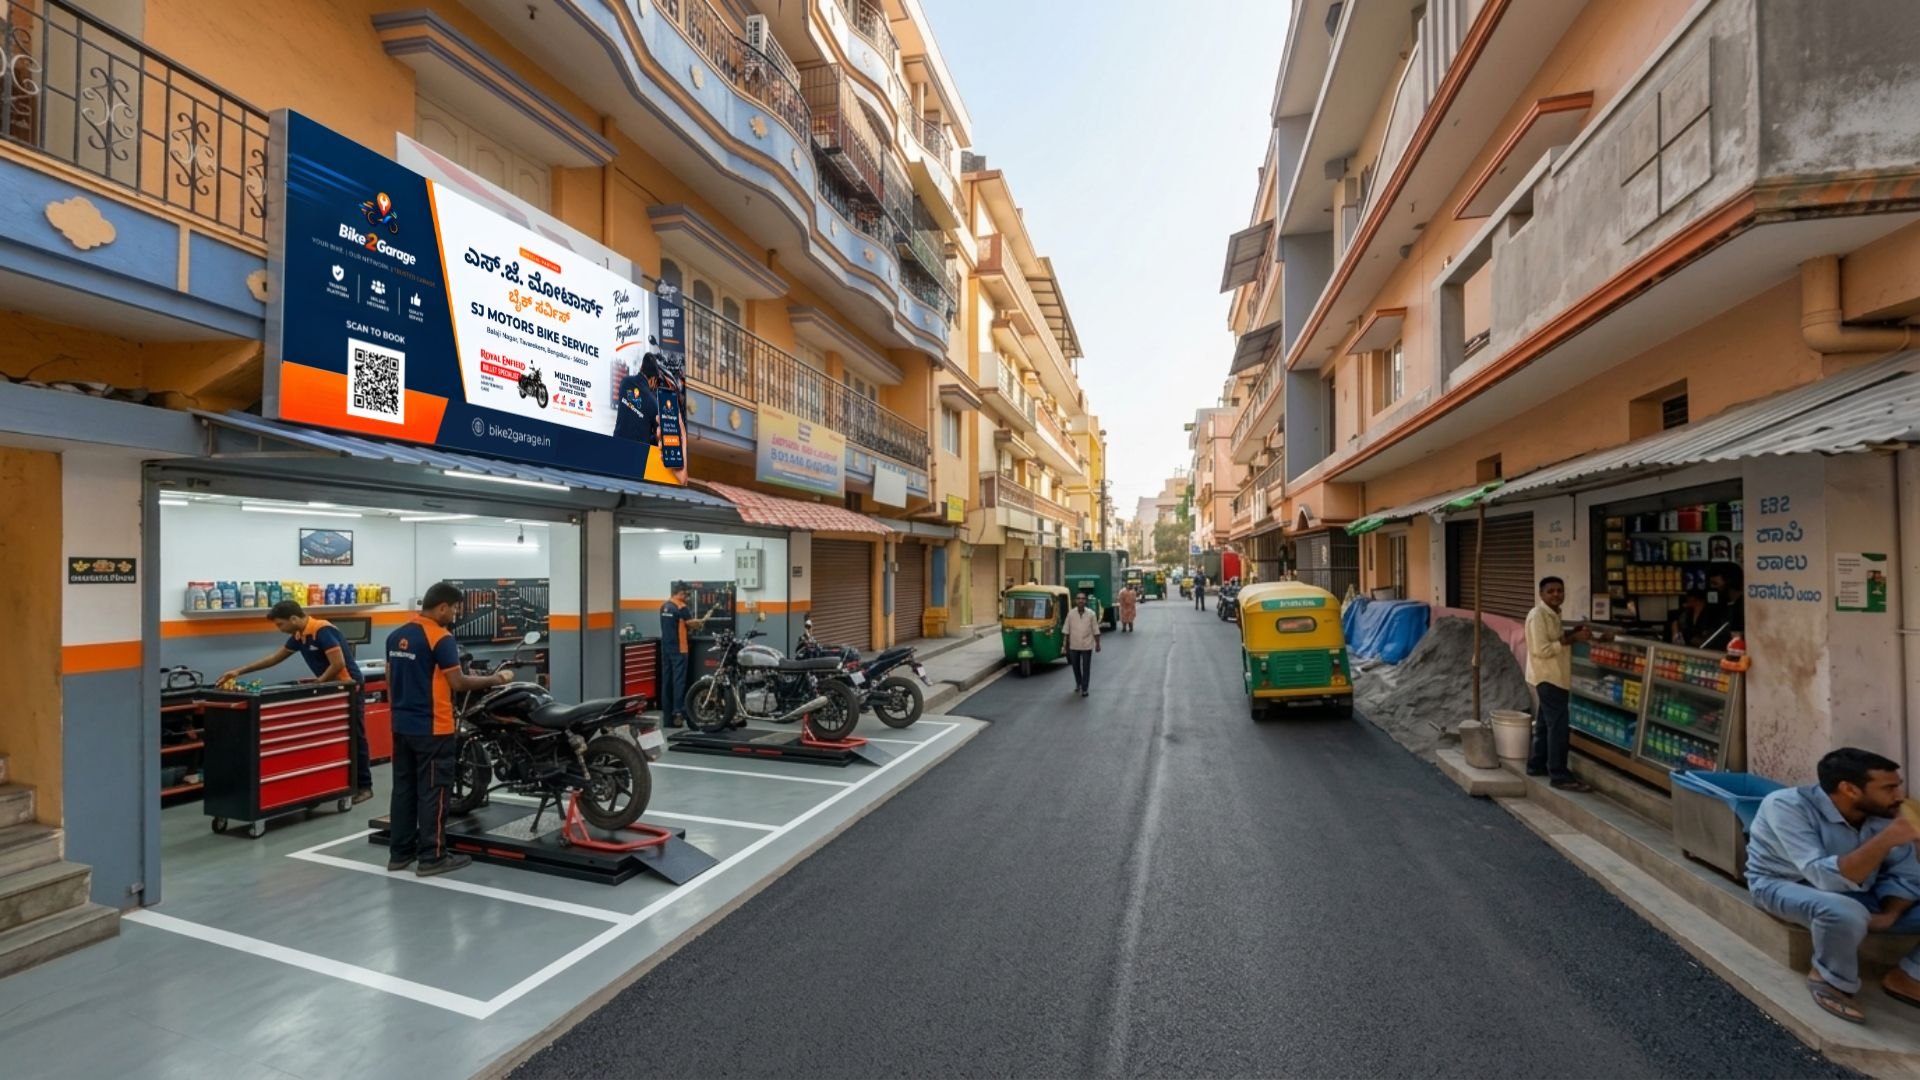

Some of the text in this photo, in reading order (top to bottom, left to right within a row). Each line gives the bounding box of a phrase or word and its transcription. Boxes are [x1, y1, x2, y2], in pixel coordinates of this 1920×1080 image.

[338, 223, 417, 266] Bike2Garage
[346, 320, 406, 344] SCAN TO BOOK
[471, 301, 600, 358] SJ MOTORS BIKE SERVICE
[486, 326, 501, 338] Balaji
[614, 322, 640, 344] Together
[480, 348, 501, 363] ROYAL
[554, 370, 592, 388] MULTI BRAND
[488, 424, 551, 447] bike2garage.in
